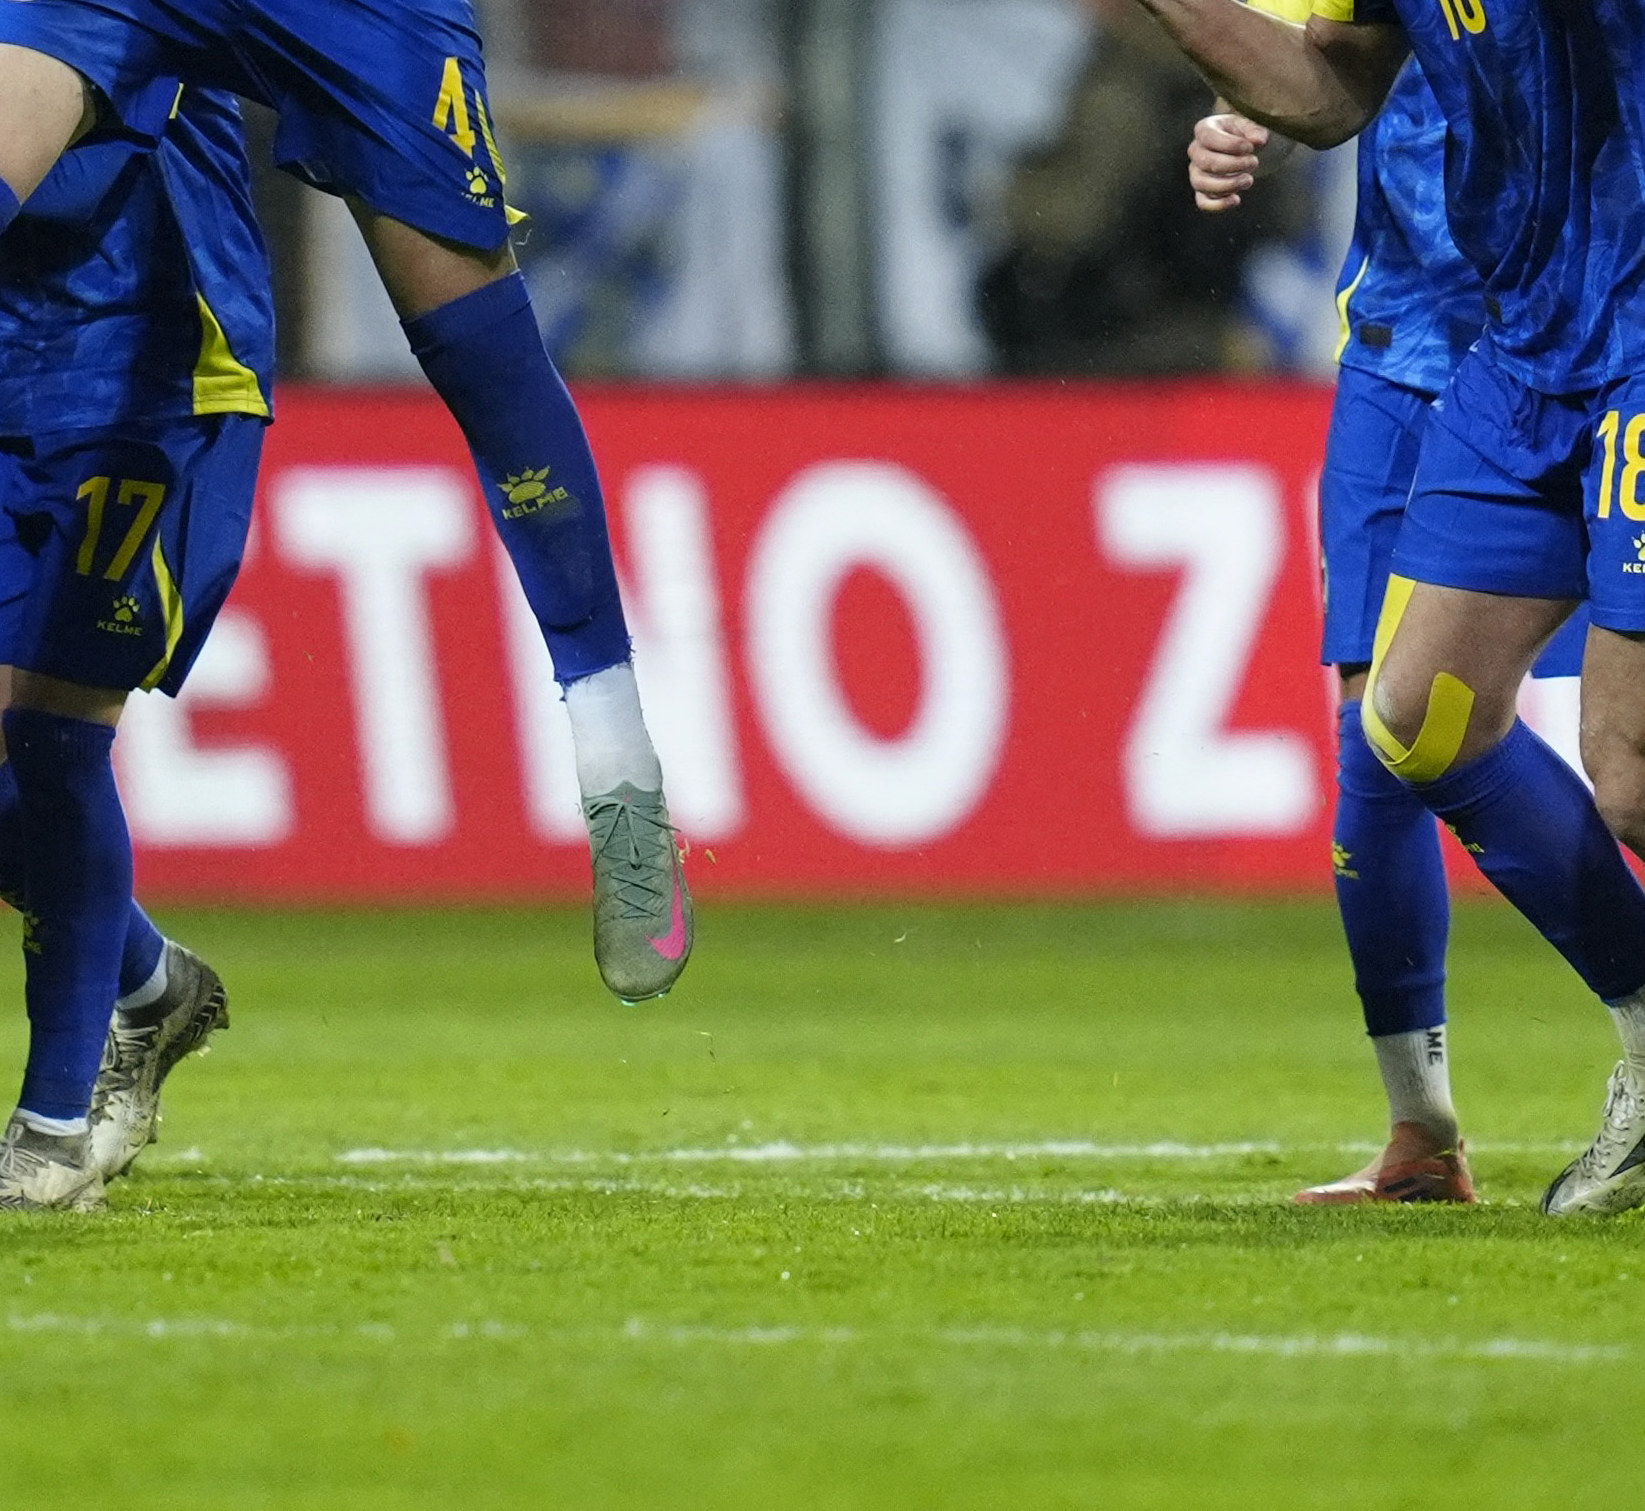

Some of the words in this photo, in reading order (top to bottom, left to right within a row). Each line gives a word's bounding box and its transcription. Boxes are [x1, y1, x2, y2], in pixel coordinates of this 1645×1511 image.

[432, 56, 477, 156] 4
[500, 492, 568, 521] KELME
[75, 475, 166, 582] 17
[95, 619, 143, 637] KELME
[1425, 1025, 1444, 1066] ME
